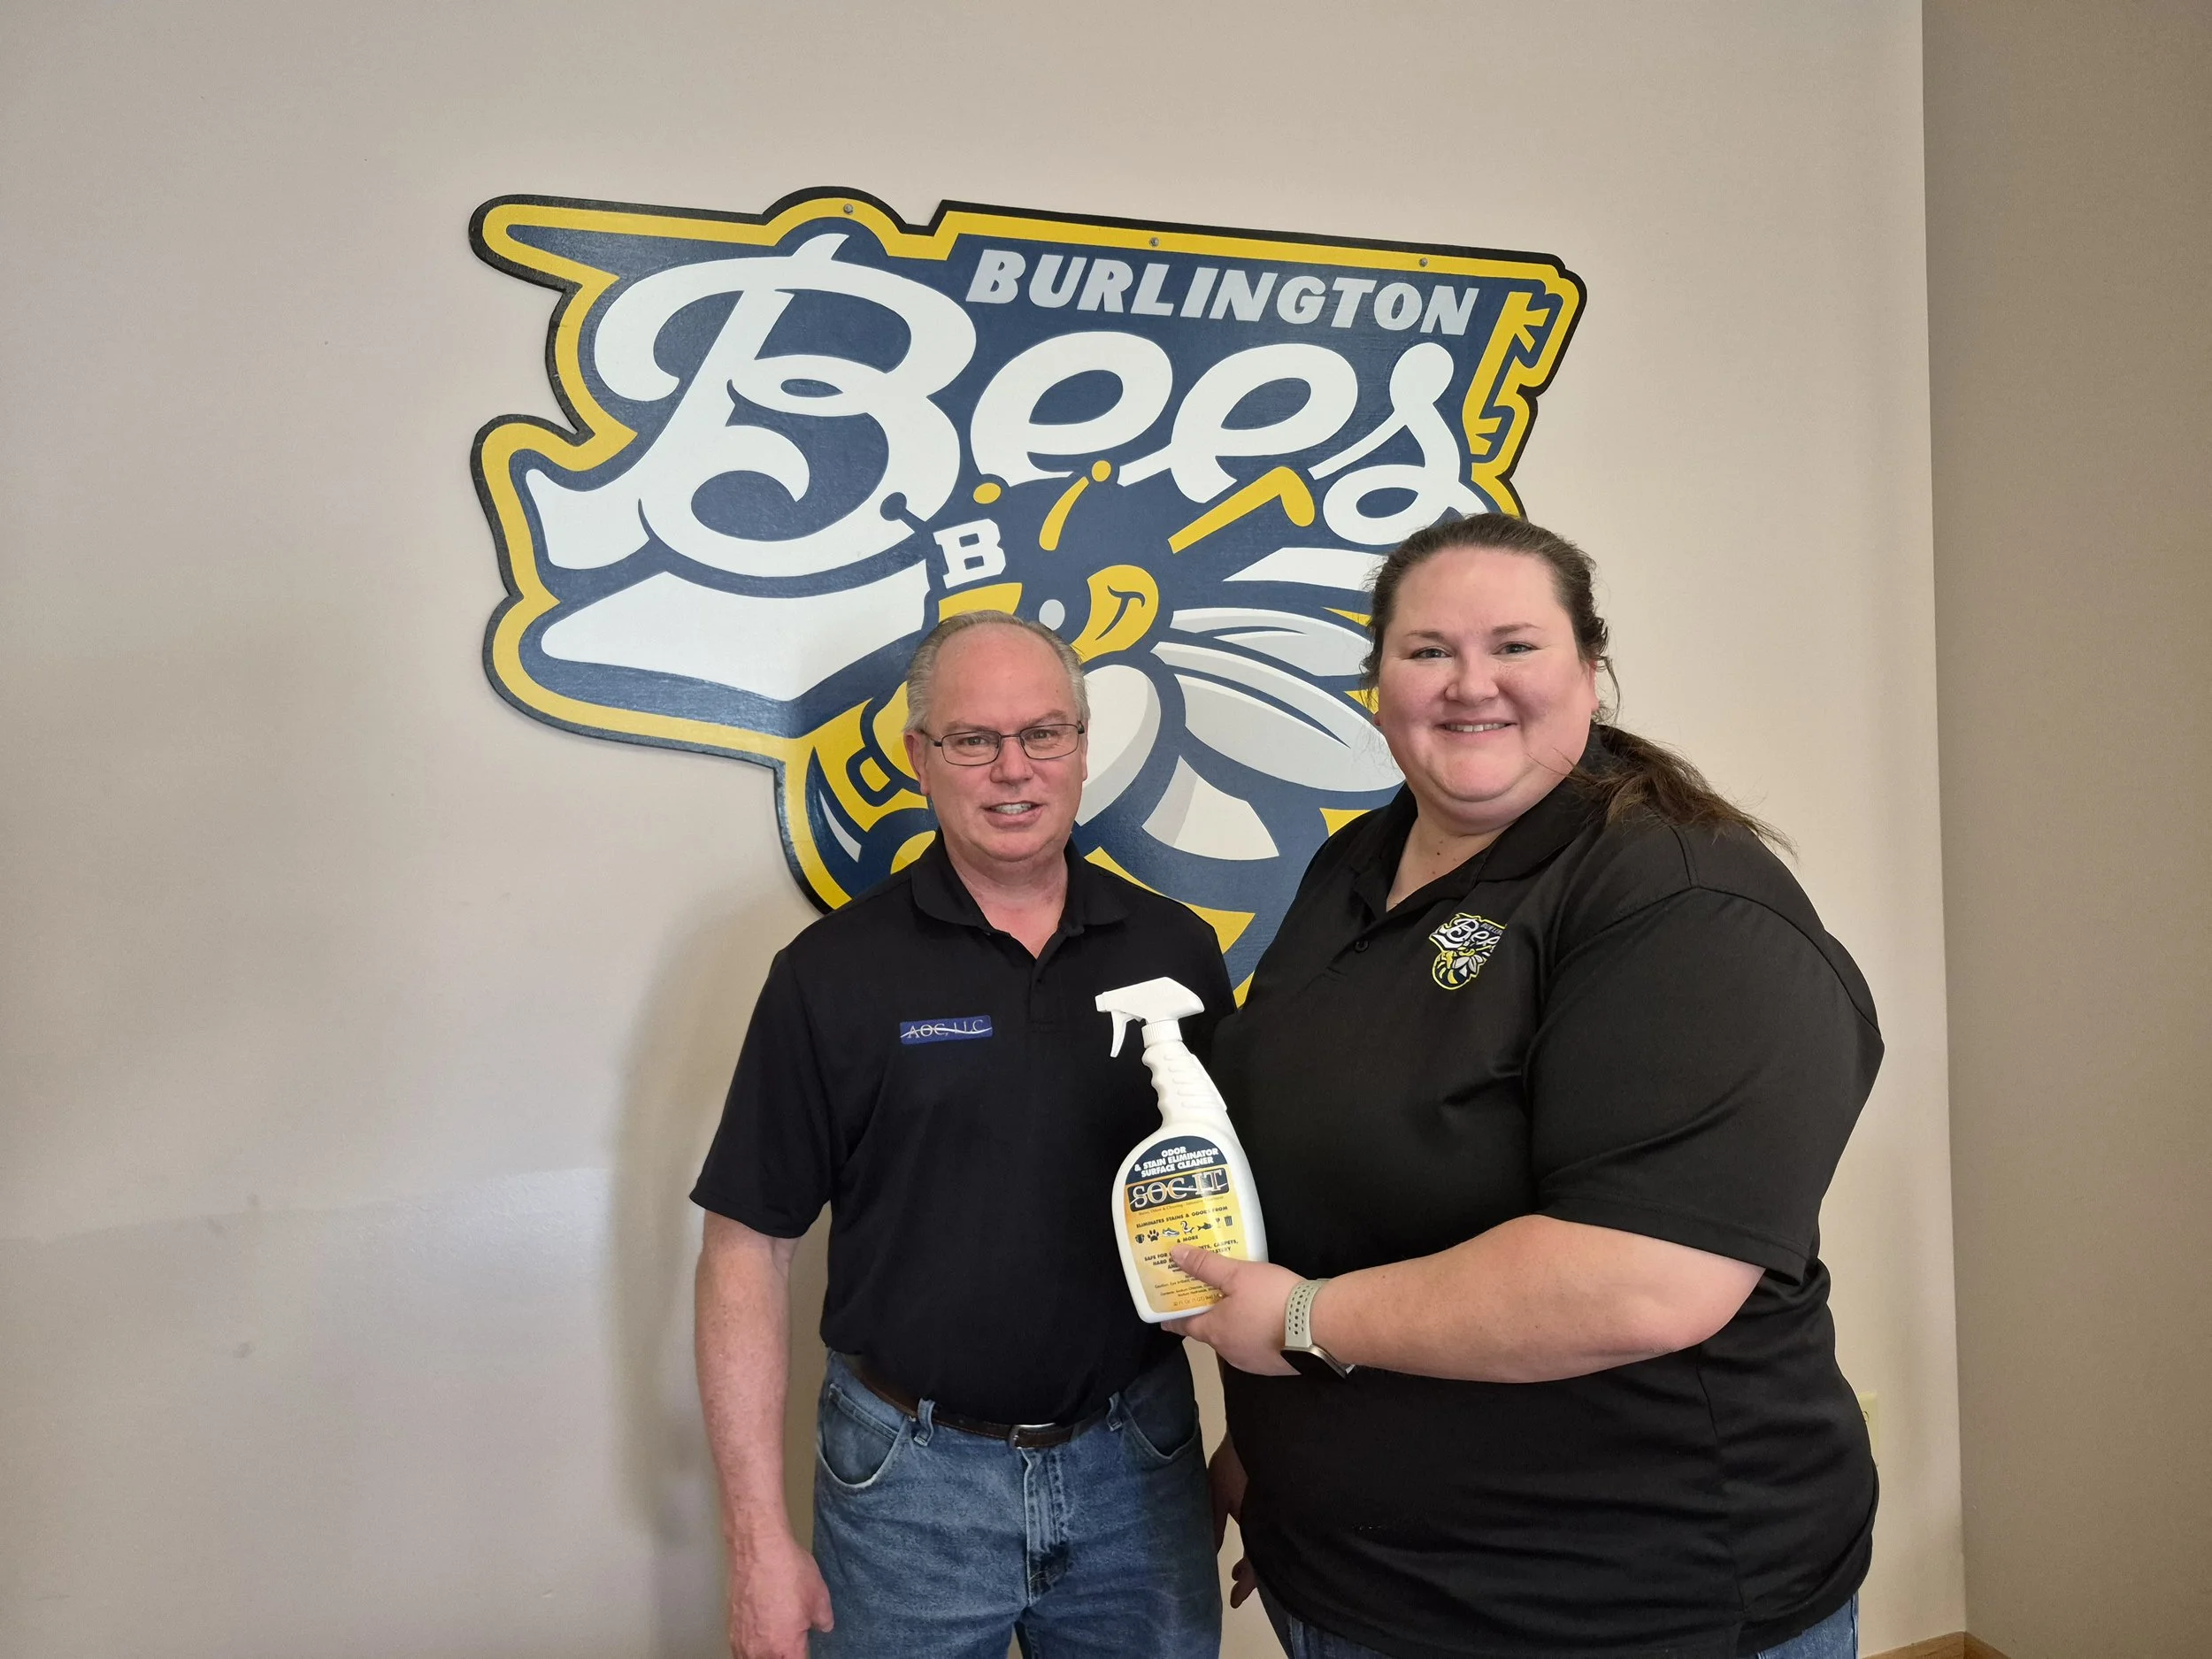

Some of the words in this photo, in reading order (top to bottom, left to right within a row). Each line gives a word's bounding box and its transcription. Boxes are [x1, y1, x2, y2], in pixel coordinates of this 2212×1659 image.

[965, 249, 1480, 336] BURLINGTON
[526, 234, 1494, 577] Bees
[933, 518, 1006, 588] B
[1141, 1164, 1176, 1178] SURFACE
[1177, 1156, 1214, 1170] CLEANER
[1142, 1157, 1166, 1170] STAIN
[1167, 1148, 1219, 1164] ELIMINATOR
[1161, 1146, 1187, 1157] ODOR
[1133, 1177, 1187, 1209] SOC
[1192, 1169, 1222, 1195] IT
[1136, 1218, 1164, 1228] ELIMINATES
